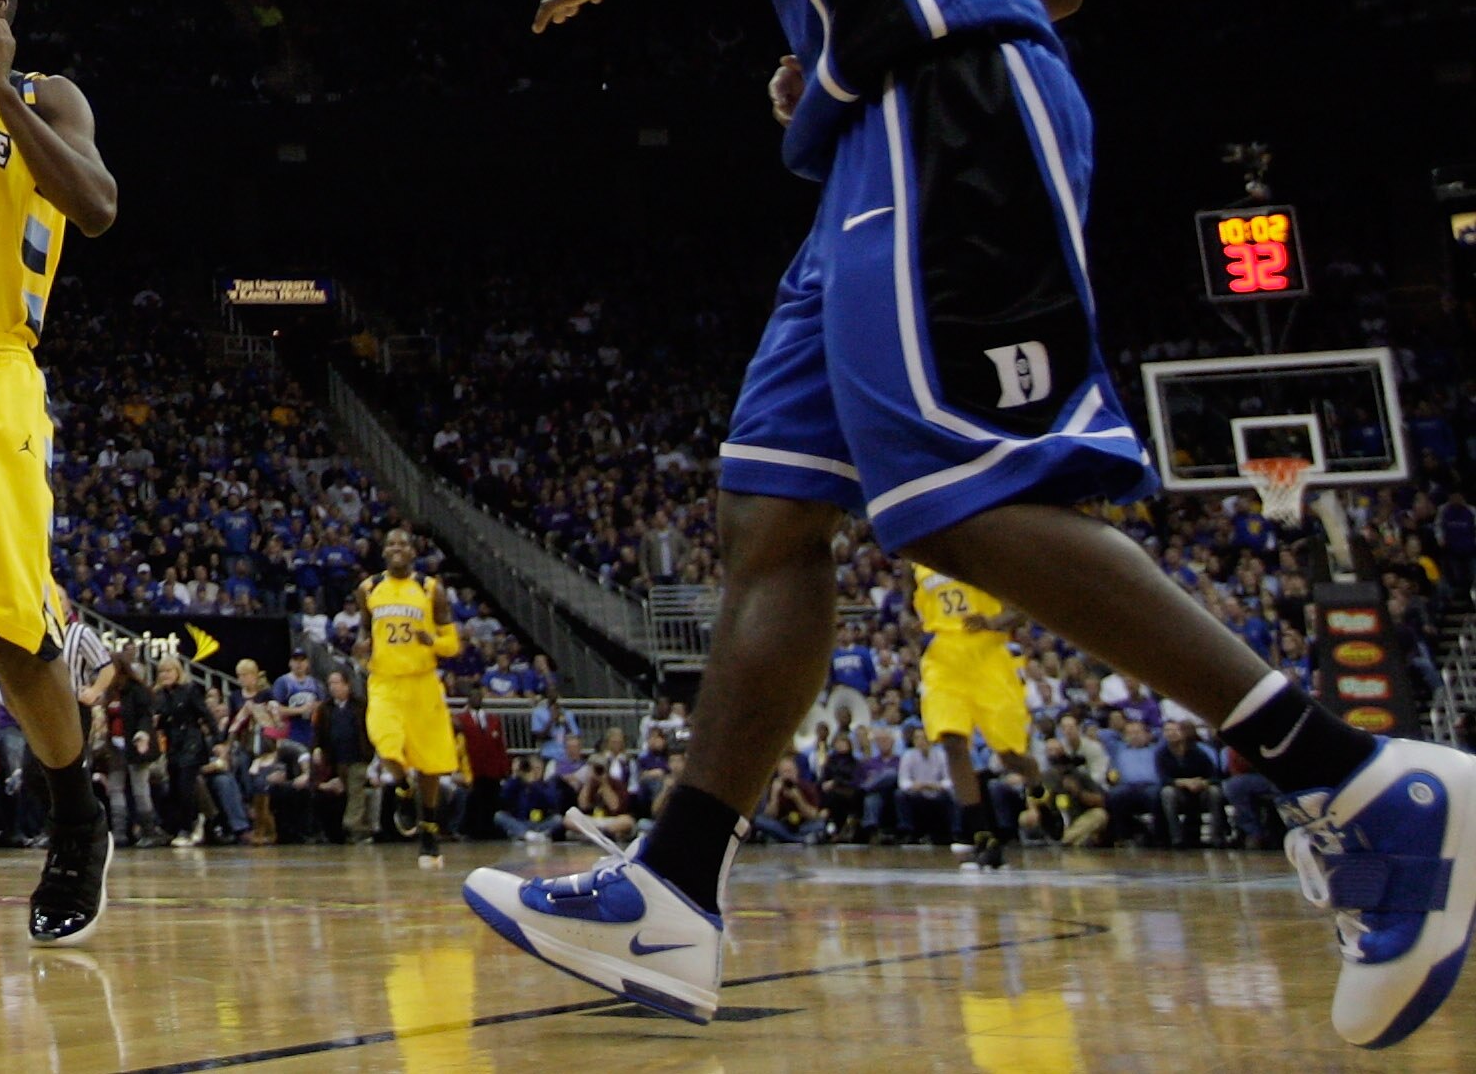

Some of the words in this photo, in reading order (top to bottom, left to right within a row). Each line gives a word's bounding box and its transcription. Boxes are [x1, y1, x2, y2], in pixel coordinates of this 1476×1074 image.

[1219, 213, 1289, 244] 10:02
[1224, 242, 1289, 293] 32
[937, 588, 967, 616] 32
[385, 622, 412, 645] 23
